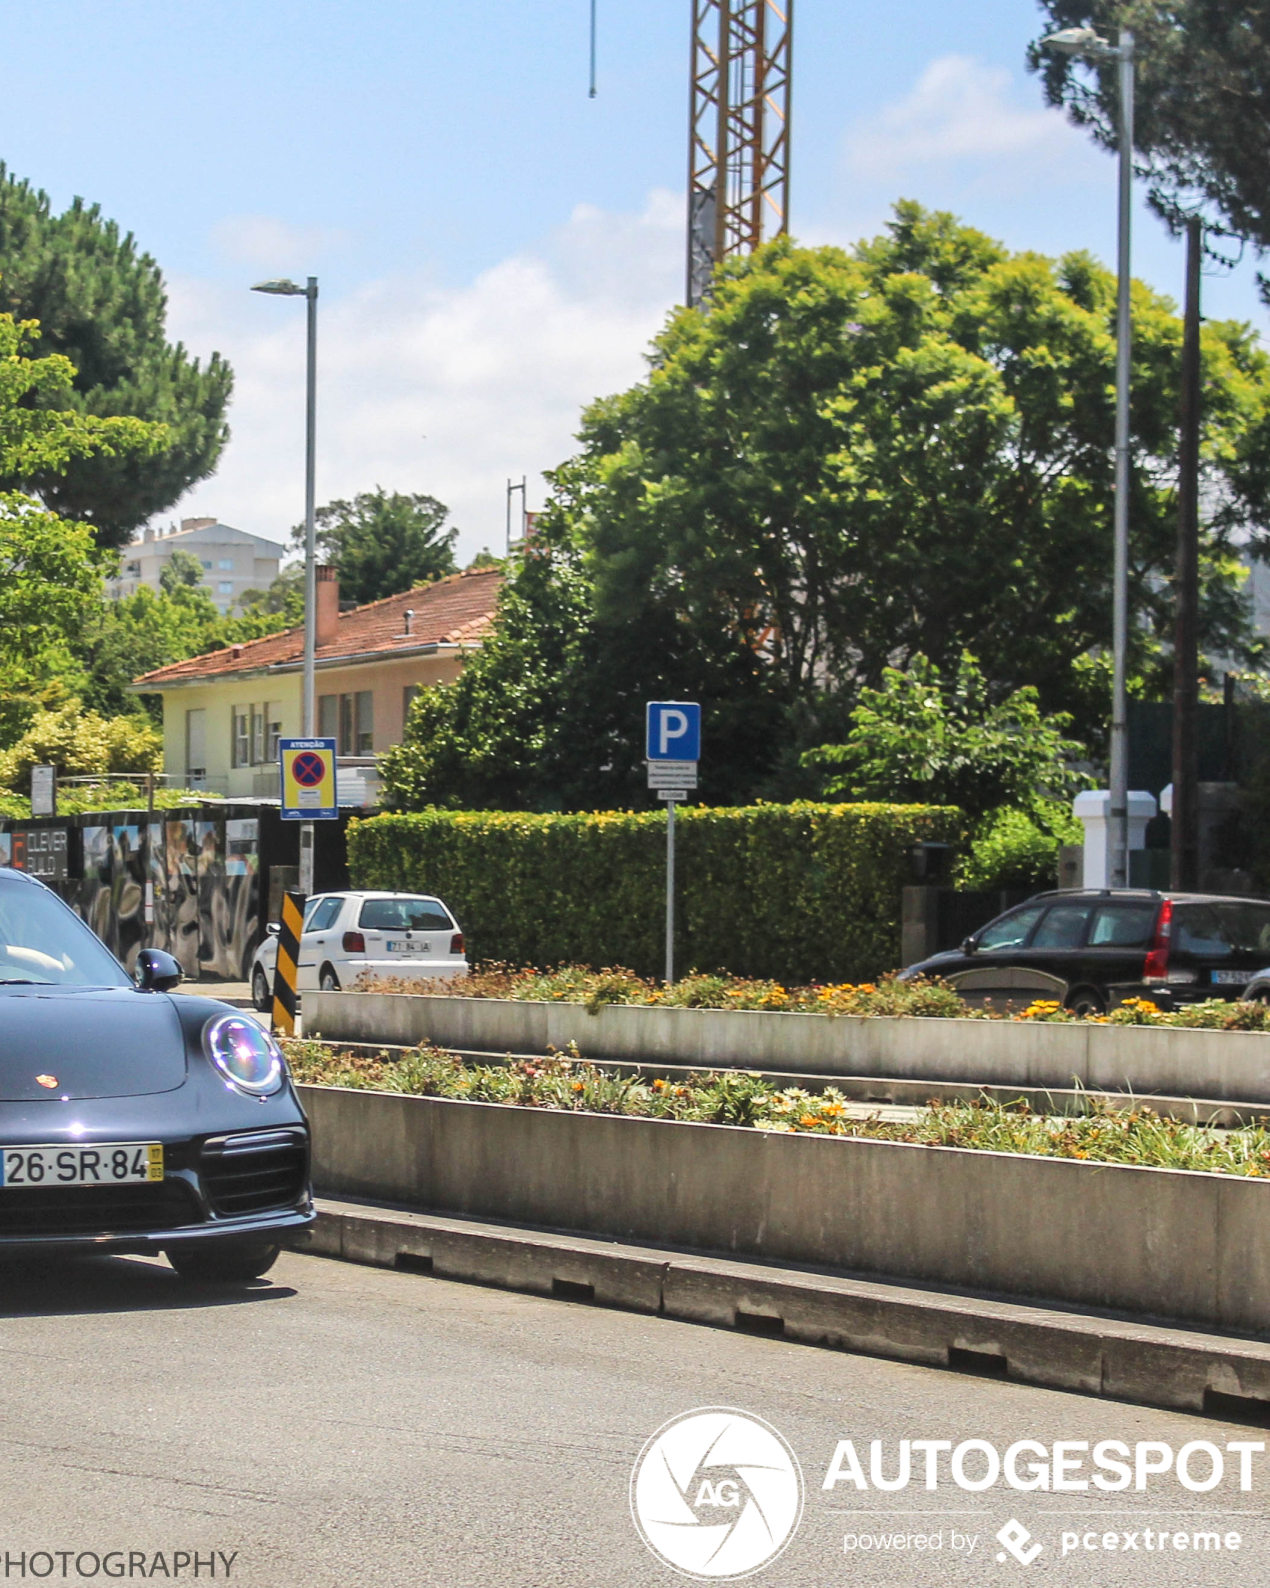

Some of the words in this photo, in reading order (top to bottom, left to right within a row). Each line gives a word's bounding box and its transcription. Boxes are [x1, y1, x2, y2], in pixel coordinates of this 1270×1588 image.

[659, 709, 688, 754] P
[289, 739, 326, 749] ATENÇÃO
[27, 831, 68, 854] CLEVER
